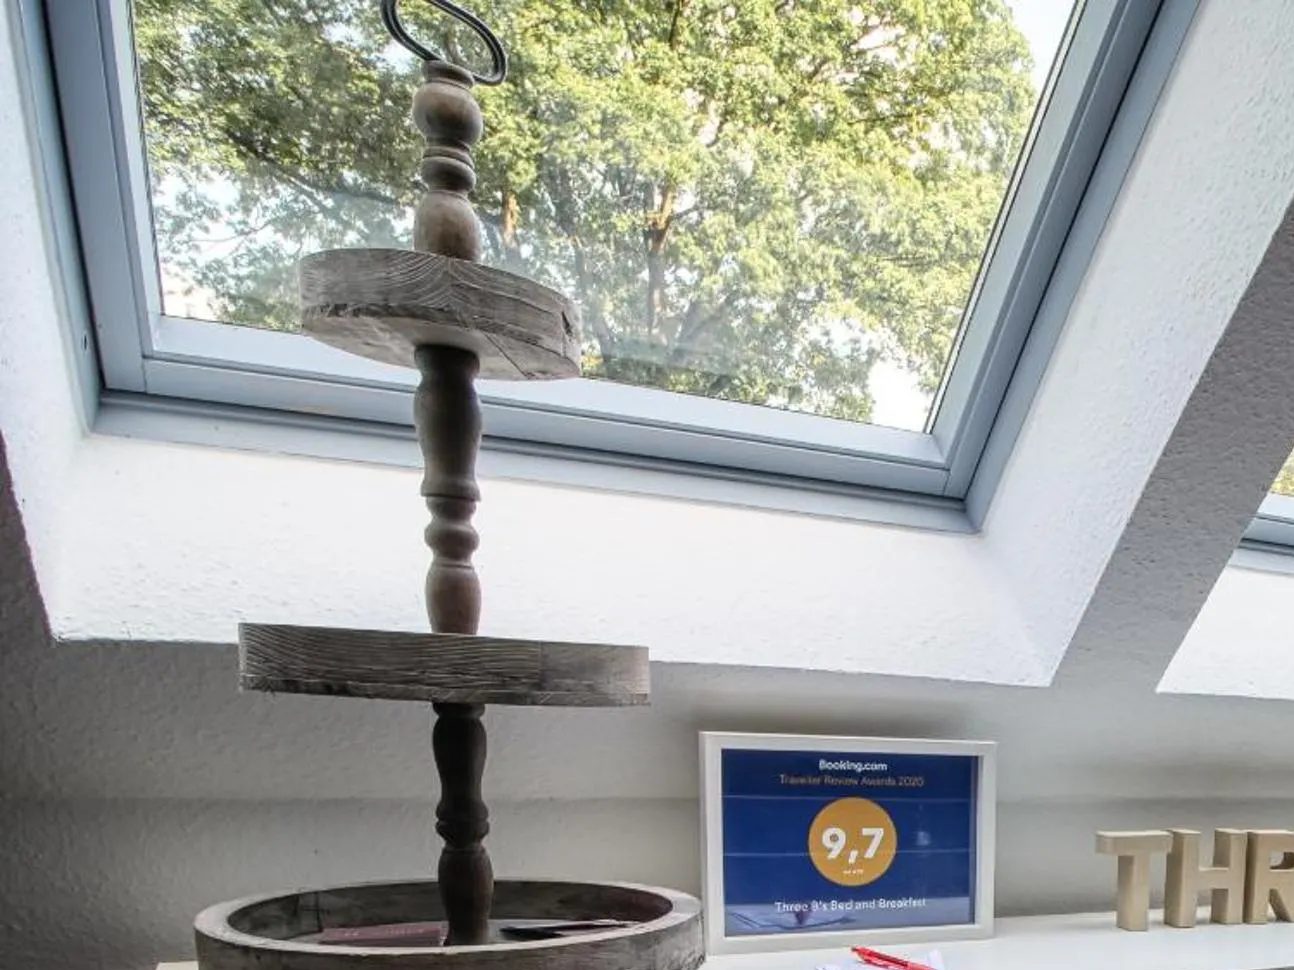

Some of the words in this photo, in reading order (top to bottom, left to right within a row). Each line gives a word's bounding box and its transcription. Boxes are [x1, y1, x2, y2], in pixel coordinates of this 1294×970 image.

[819, 758, 889, 773] Booking.com
[824, 774, 859, 786] Review
[860, 776, 896, 787] Awards
[898, 776, 925, 788] 2020
[821, 826, 885, 865] 9,7
[774, 901, 809, 913] Three
[811, 900, 828, 912] B's
[830, 899, 854, 911] Bed
[855, 898, 876, 910] and
[878, 897, 927, 909] Breakfast
